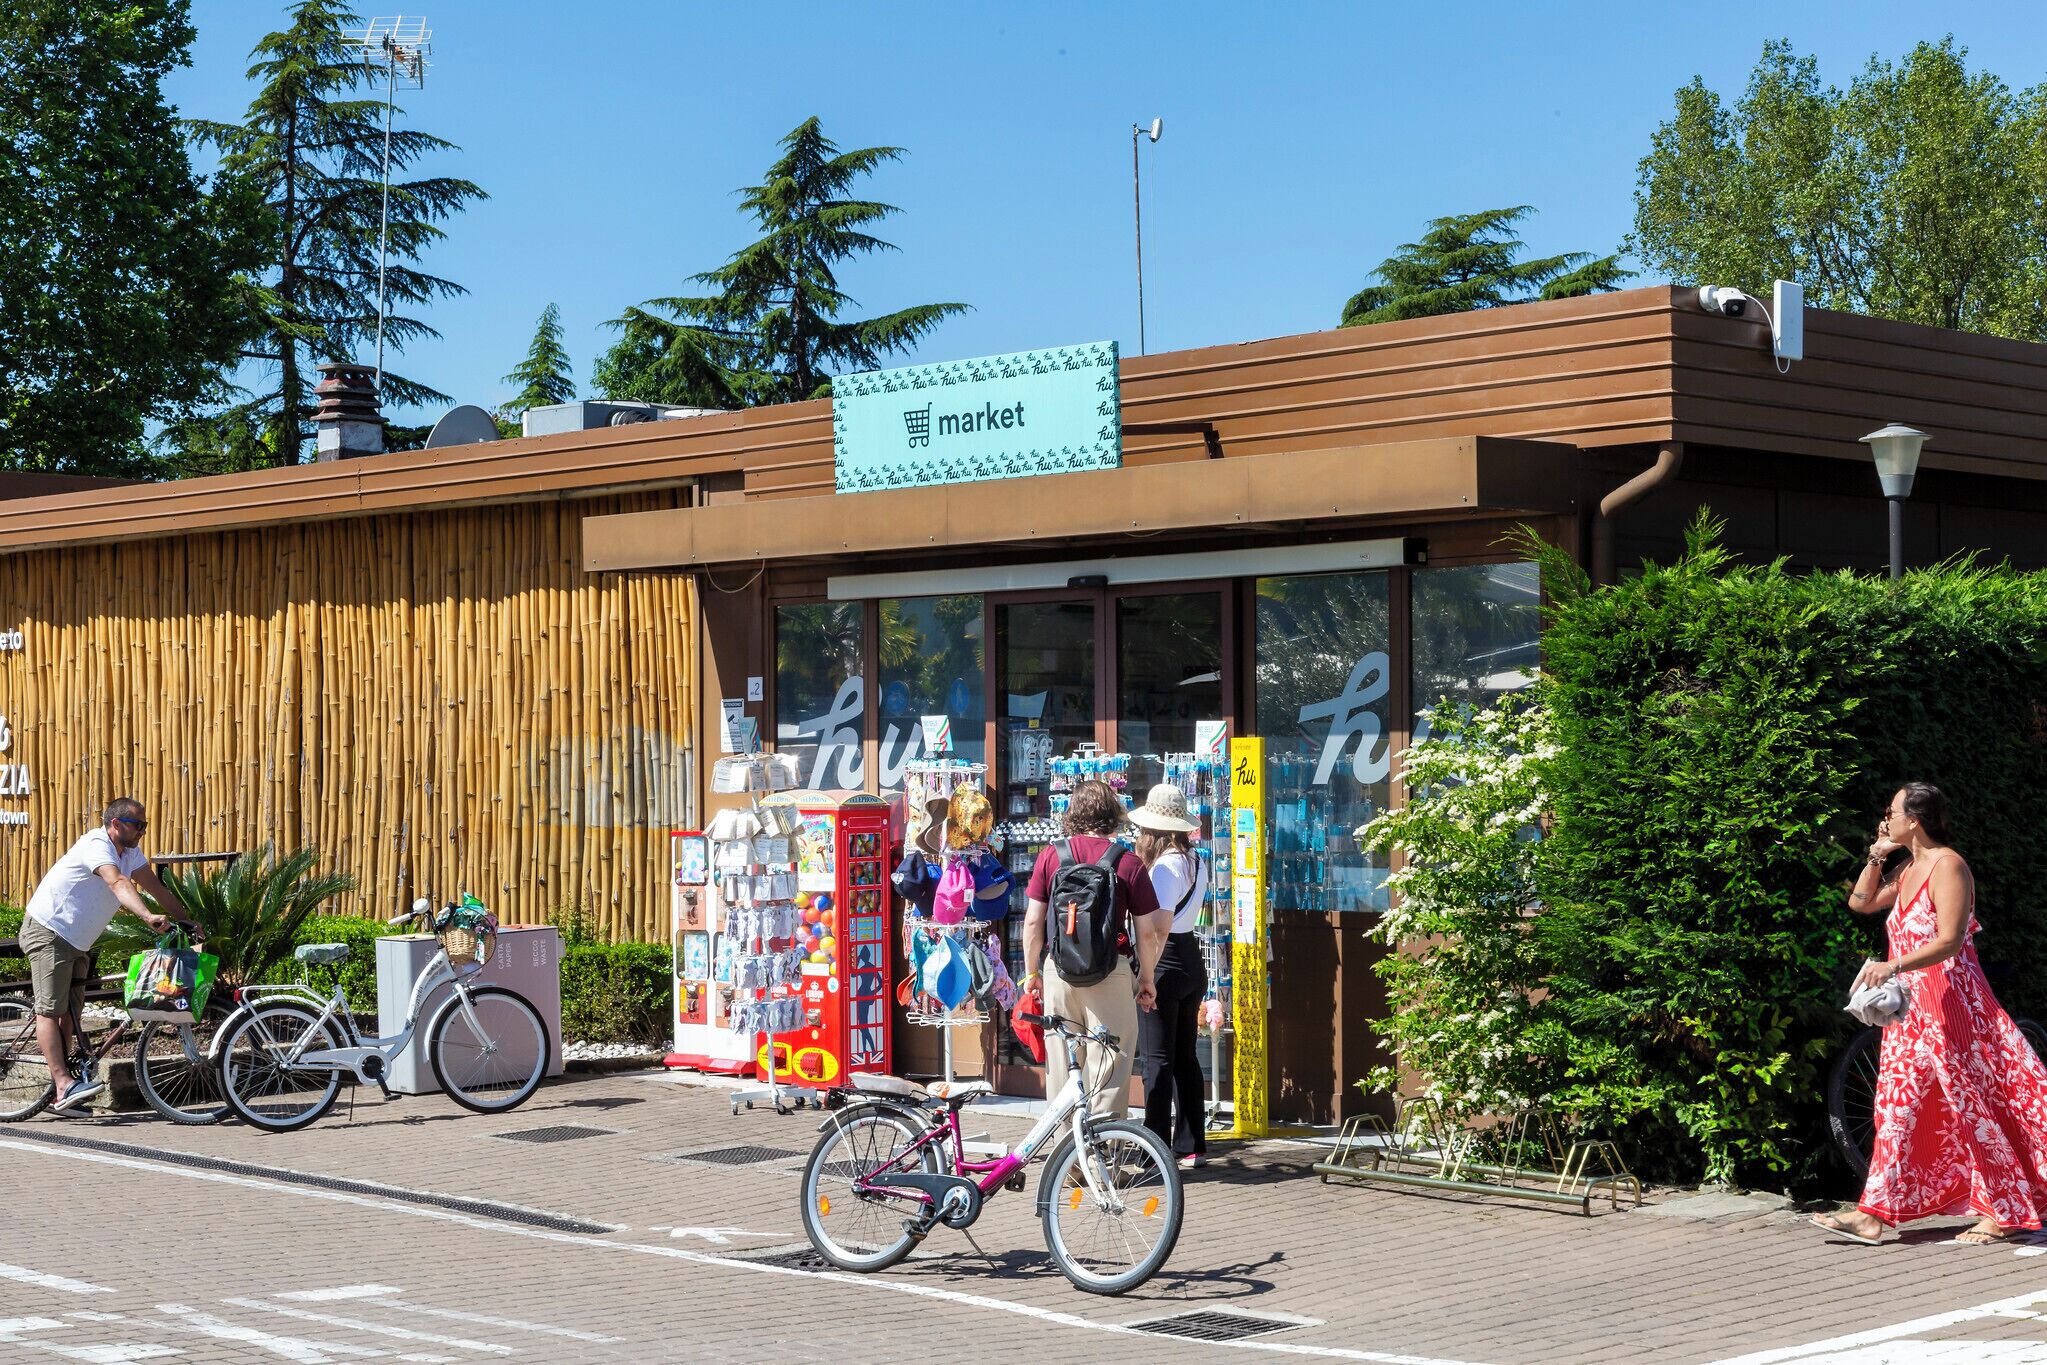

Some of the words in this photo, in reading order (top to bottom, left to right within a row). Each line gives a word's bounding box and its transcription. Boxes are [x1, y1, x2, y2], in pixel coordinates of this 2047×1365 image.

[965, 360, 975, 370] hu
[1058, 349, 1068, 358] hu
[1075, 348, 1085, 357] hu
[1090, 344, 1100, 354] hu
[842, 387, 853, 397] hu
[854, 382, 870, 397] hu
[870, 383, 881, 394] hu
[882, 379, 898, 394] hu
[898, 380, 909, 390] hu
[911, 375, 927, 390] hu
[927, 376, 938, 386] hu
[940, 372, 956, 386] hu
[957, 372, 968, 383] hu
[970, 368, 986, 382] hu
[987, 368, 998, 379] hu
[1000, 364, 1017, 379] hu
[1018, 365, 1029, 375] hu
[1031, 360, 1048, 375] hu
[1049, 361, 1061, 372] hu
[1063, 356, 1080, 371] hu
[1080, 357, 1093, 367] hu
[1095, 352, 1113, 368] hu
[1096, 376, 1114, 392] hu
[938, 401, 1025, 436] market
[1096, 401, 1115, 416] hu
[1097, 425, 1115, 441] hu
[1030, 449, 1040, 458] hu
[1061, 446, 1071, 455] hu
[1078, 446, 1088, 454] hu
[1093, 443, 1104, 452] hu
[846, 478, 856, 488] hu
[858, 474, 873, 488] hu
[873, 475, 884, 485] hu
[886, 471, 902, 486] hu
[902, 472, 913, 482] hu
[914, 468, 931, 483] hu
[930, 470, 942, 480] hu
[944, 465, 960, 480] hu
[960, 466, 972, 477] hu
[974, 462, 990, 477] hu
[990, 464, 1002, 474] hu
[1004, 459, 1021, 474] hu
[1021, 461, 1033, 471] hu
[1035, 456, 1052, 472] hu
[1052, 458, 1064, 468] hu
[1066, 453, 1084, 468] hu
[1084, 454, 1096, 465] hu
[1098, 450, 1116, 466] hu
[0, 628, 23, 650] eto
[754, 683, 760, 695] 2
[0, 764, 30, 794] ZIA
[1235, 756, 1256, 785] hu
[0, 809, 28, 824] town
